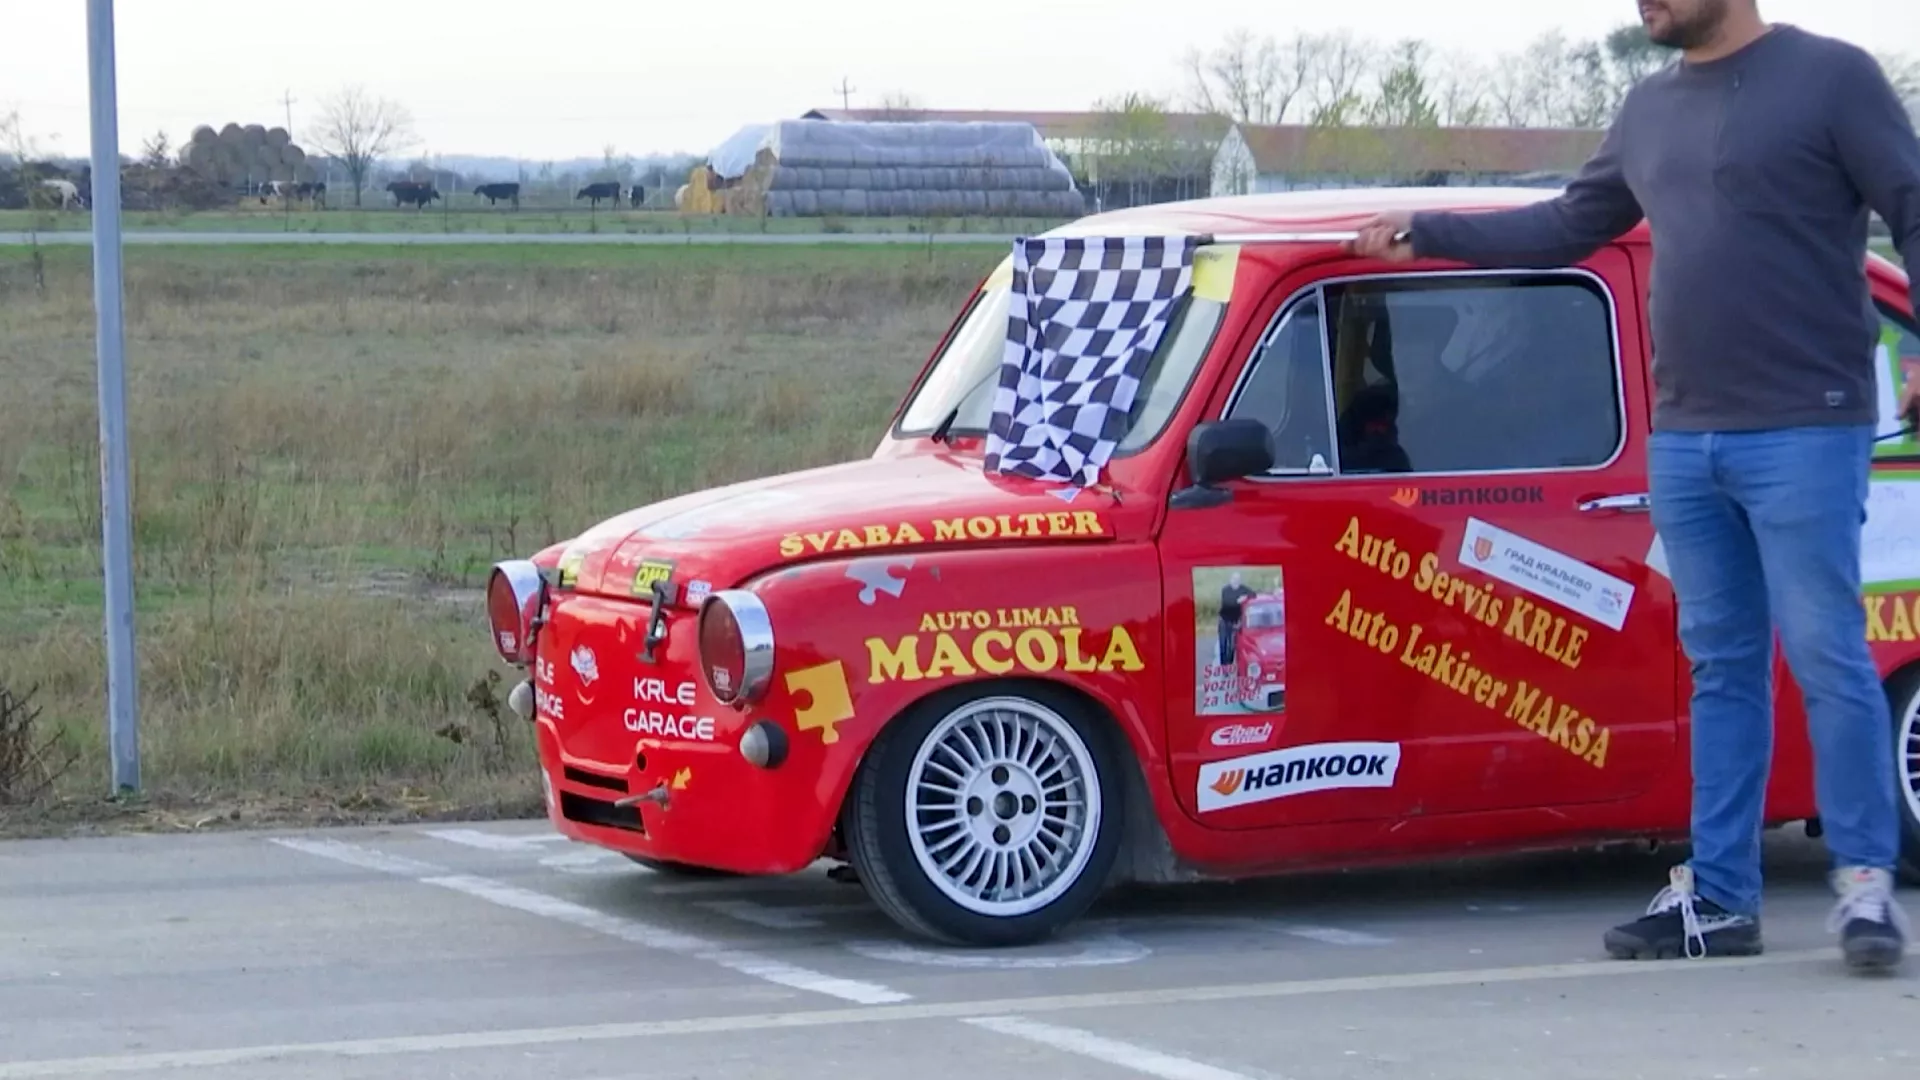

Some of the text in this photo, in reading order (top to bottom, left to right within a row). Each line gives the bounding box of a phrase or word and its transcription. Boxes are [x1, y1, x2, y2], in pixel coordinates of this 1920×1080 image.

[780, 510, 1104, 557] ŠVABA MOLTER
[1504, 547, 1592, 592] ГРАД КРАЉЕВО
[1334, 516, 1590, 669] Auto Servis KRLE
[919, 606, 1080, 632] AUTO LIMAR
[1864, 594, 1920, 642] KA
[536, 655, 554, 685] RLE
[865, 624, 1145, 684] MACOLA
[633, 676, 696, 706] KRLE
[1325, 589, 1613, 769] Auto Lakirer MAKSA
[624, 707, 715, 741] GARAGE
[1211, 722, 1272, 746] Eibach
